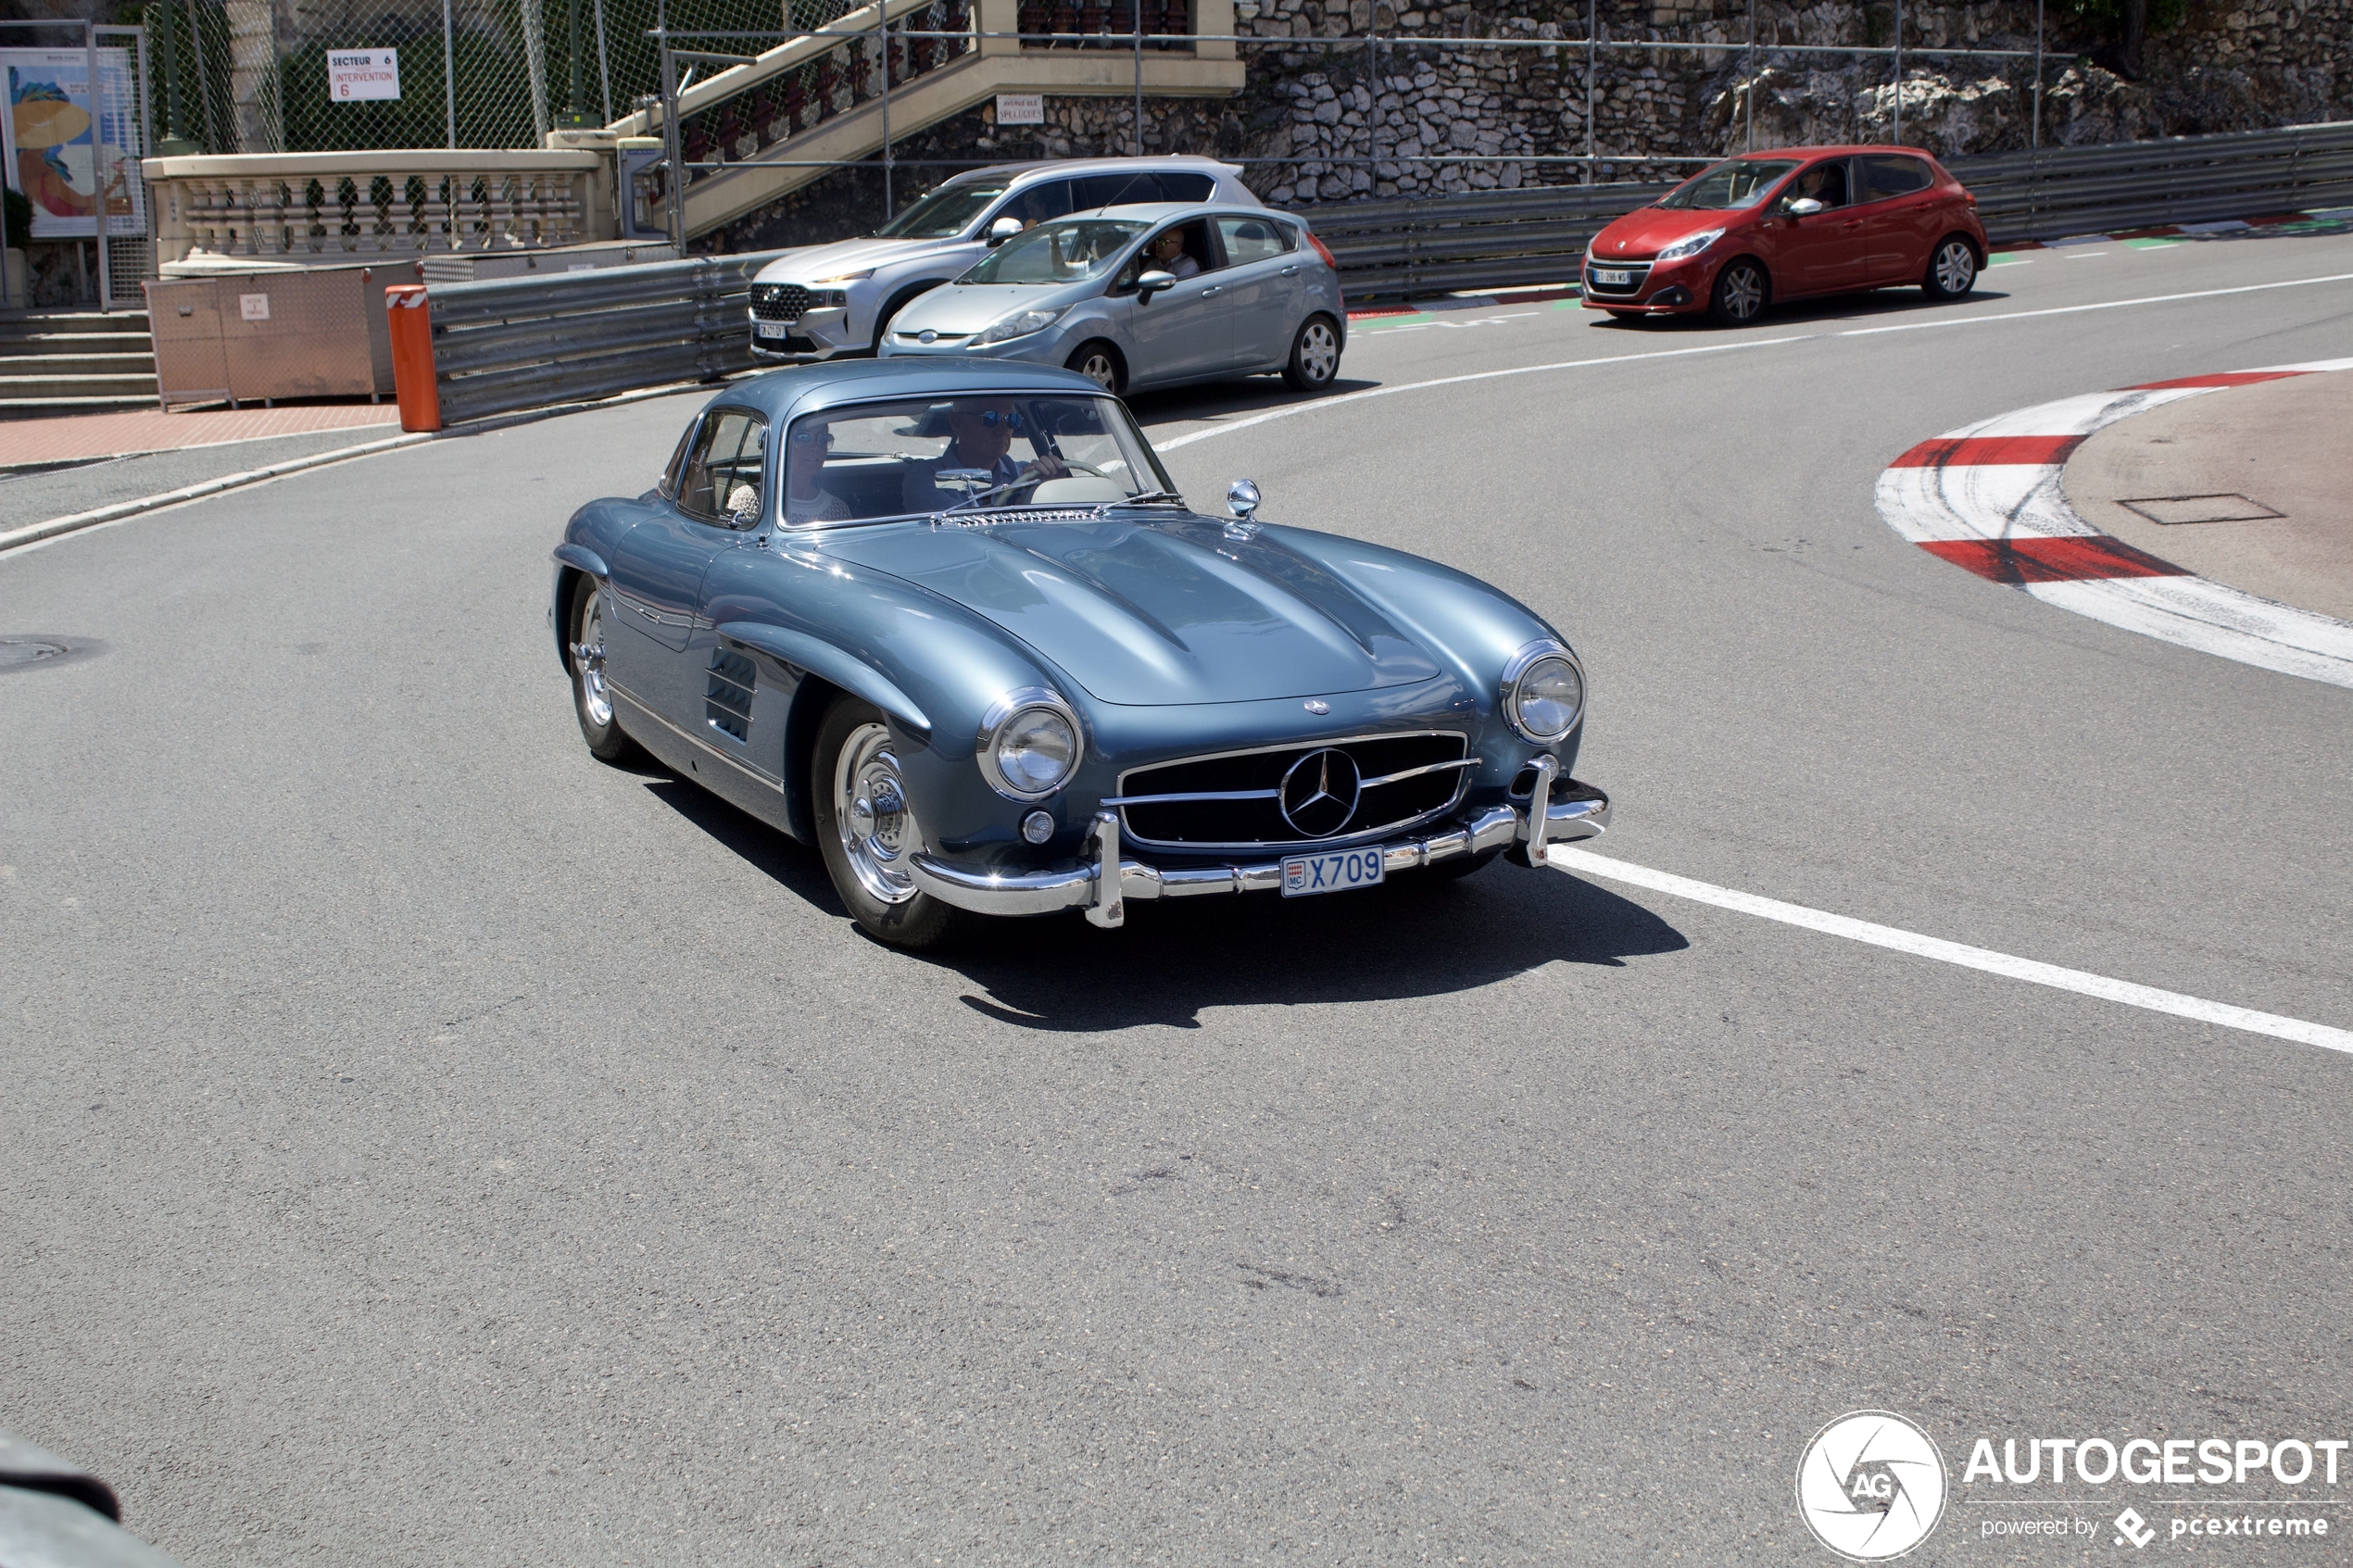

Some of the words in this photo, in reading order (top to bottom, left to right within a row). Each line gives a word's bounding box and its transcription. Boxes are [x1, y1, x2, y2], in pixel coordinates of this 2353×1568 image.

[333, 56, 371, 67] SECTEUR
[384, 56, 391, 65] 6
[335, 72, 393, 83] INTERVENTION
[340, 83, 349, 97] 6
[1000, 109, 1042, 119] SPELUGUES
[1290, 876, 1302, 884] MC
[1310, 852, 1379, 888] X709
